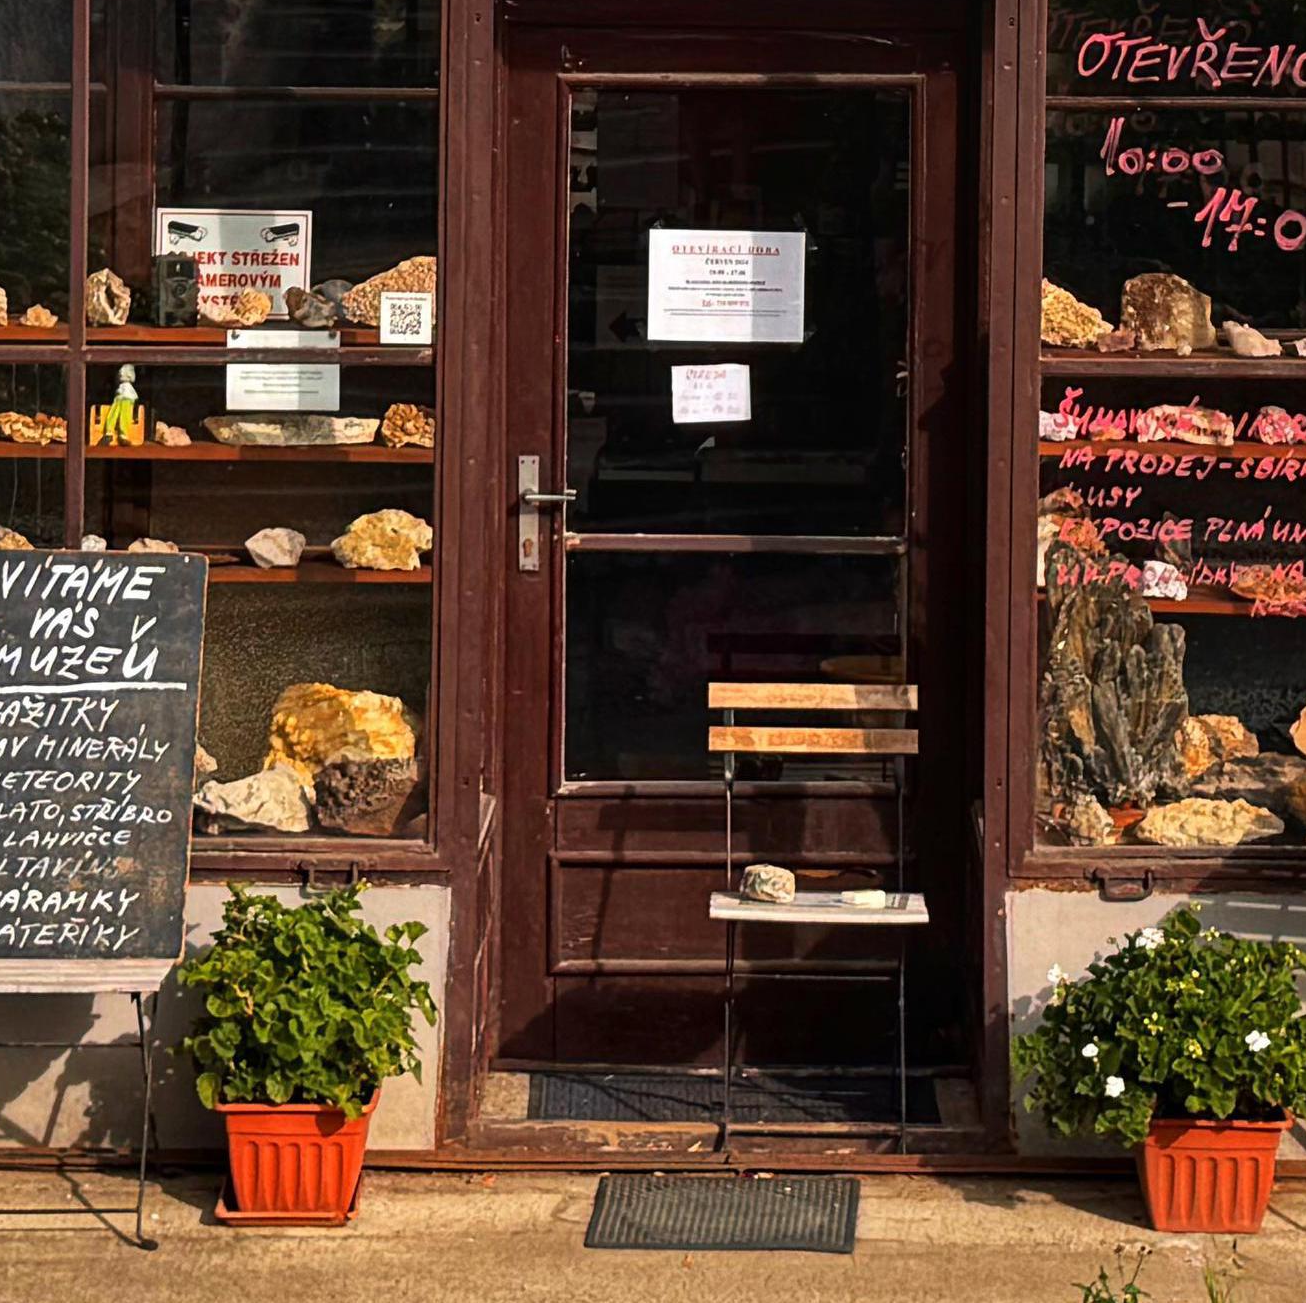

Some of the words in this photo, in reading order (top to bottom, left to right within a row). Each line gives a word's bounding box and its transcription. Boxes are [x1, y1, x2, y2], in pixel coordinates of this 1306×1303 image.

[1100, 117, 1225, 176] 10:00
[231, 248, 300, 266] STŘEŽEN
[196, 270, 282, 289] AMEROVÝM
[1059, 446, 1096, 471] NA
[1204, 505, 1272, 542] PLNÁ
[0, 555, 166, 604] VÍTÁME
[30, 601, 97, 640] VÁS
[34, 722, 171, 765] MINERÁLY
